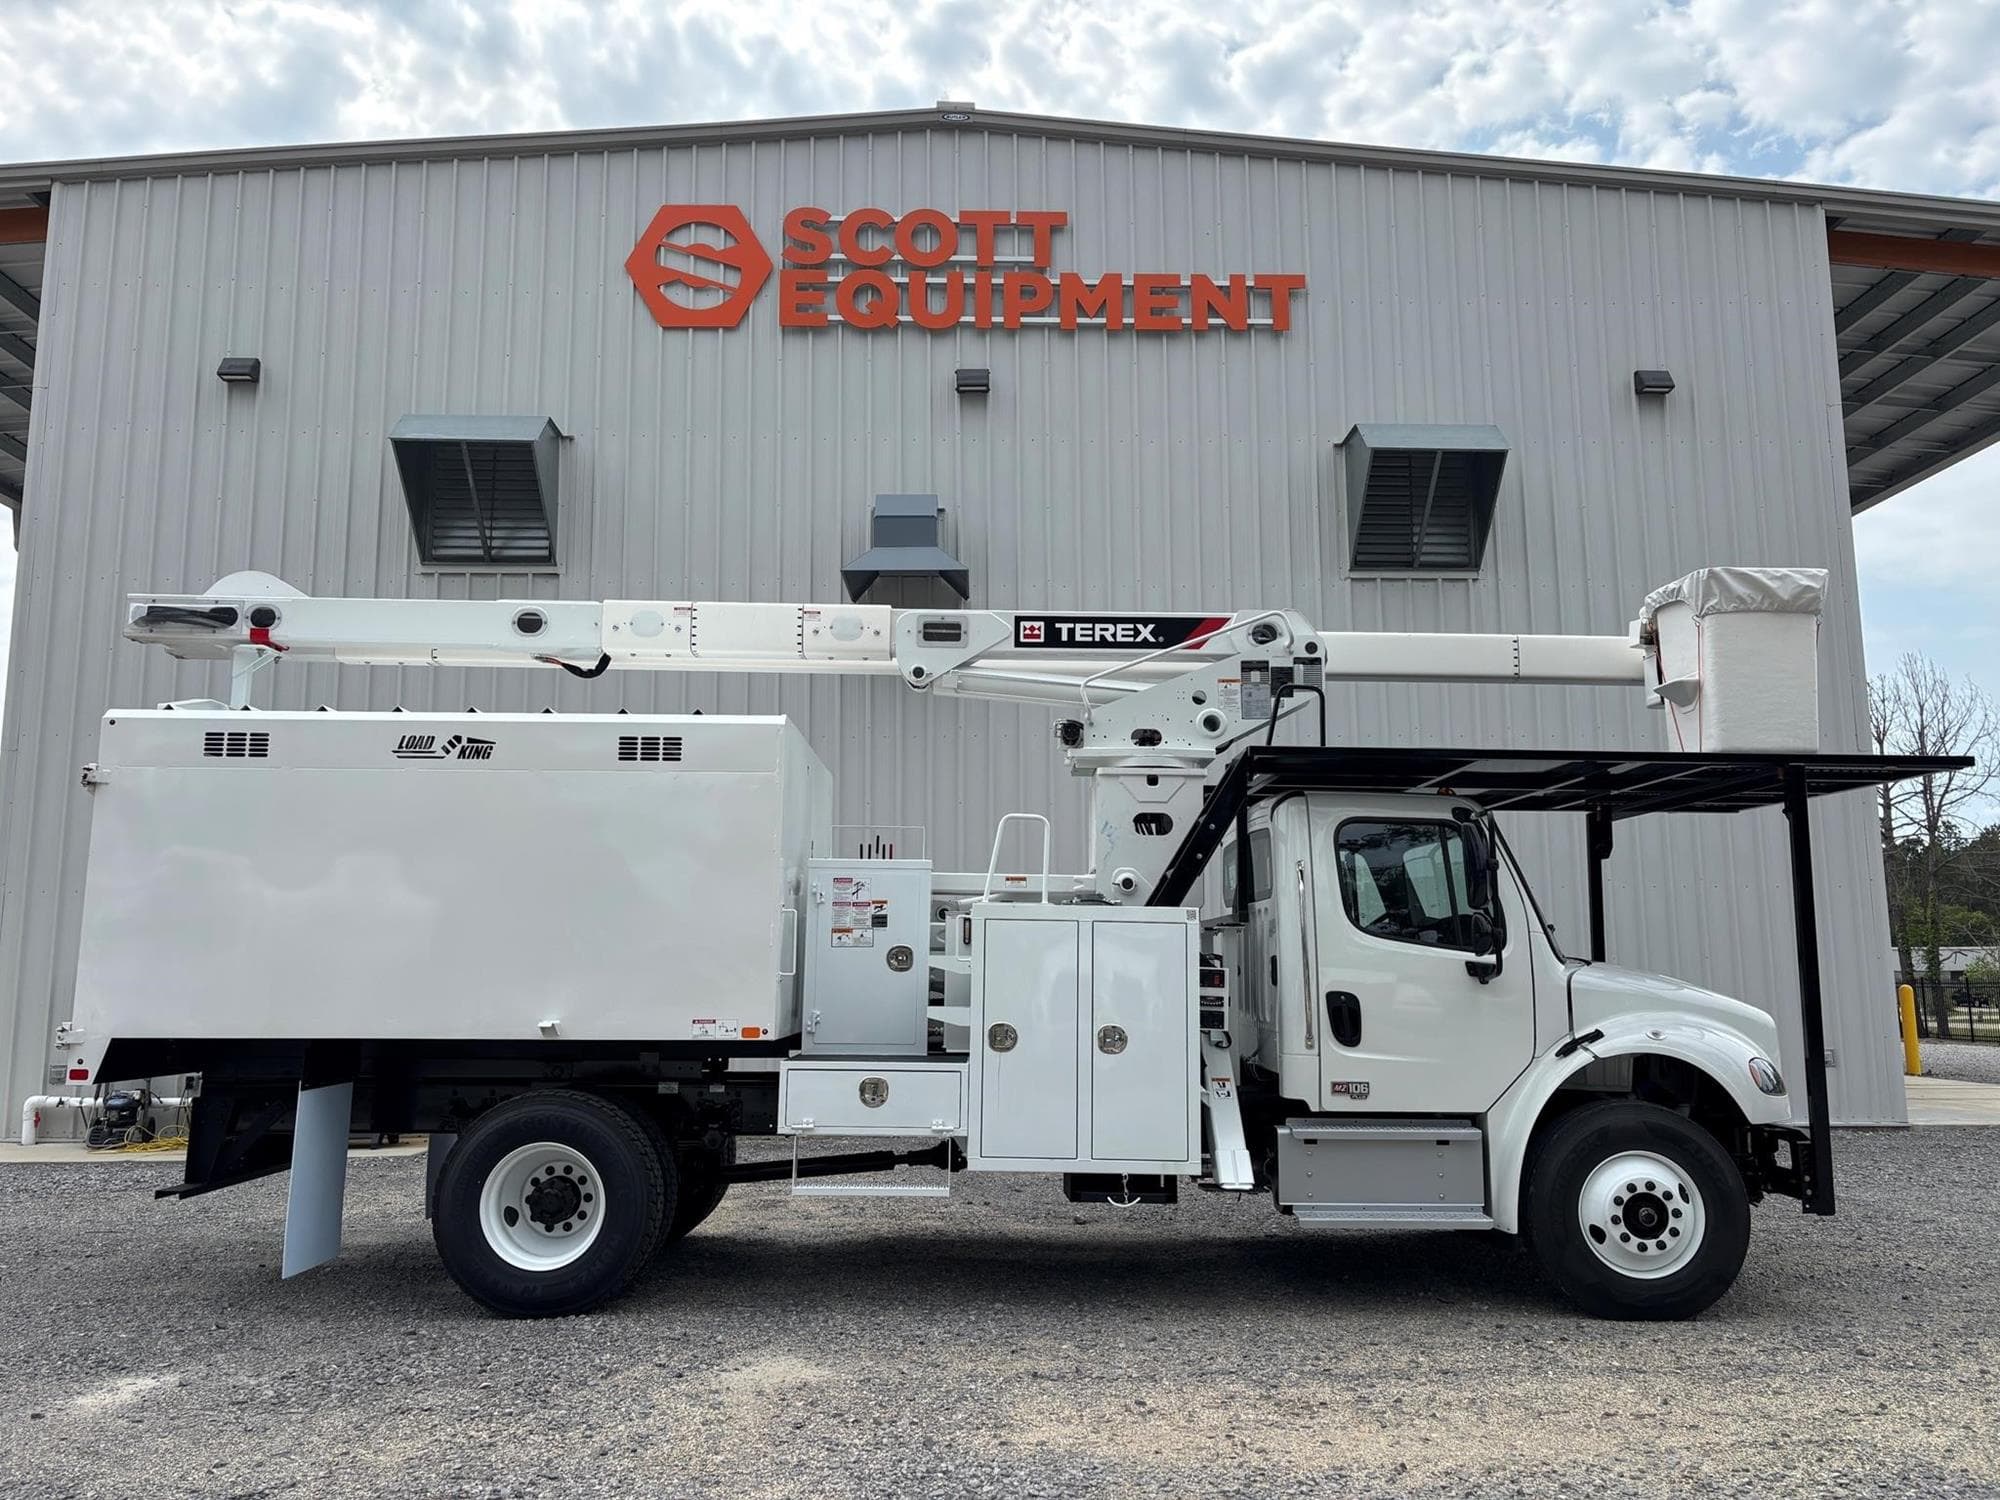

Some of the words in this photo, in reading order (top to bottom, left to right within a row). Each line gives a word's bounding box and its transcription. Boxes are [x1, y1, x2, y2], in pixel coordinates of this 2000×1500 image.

[783, 207, 1068, 268] SCOTT
[779, 269, 1306, 331] EQUIPMENT
[1054, 622, 1157, 642] TEREX
[397, 735, 435, 749] LOAD
[457, 745, 493, 759] KING
[1348, 1083, 1369, 1094] 106
